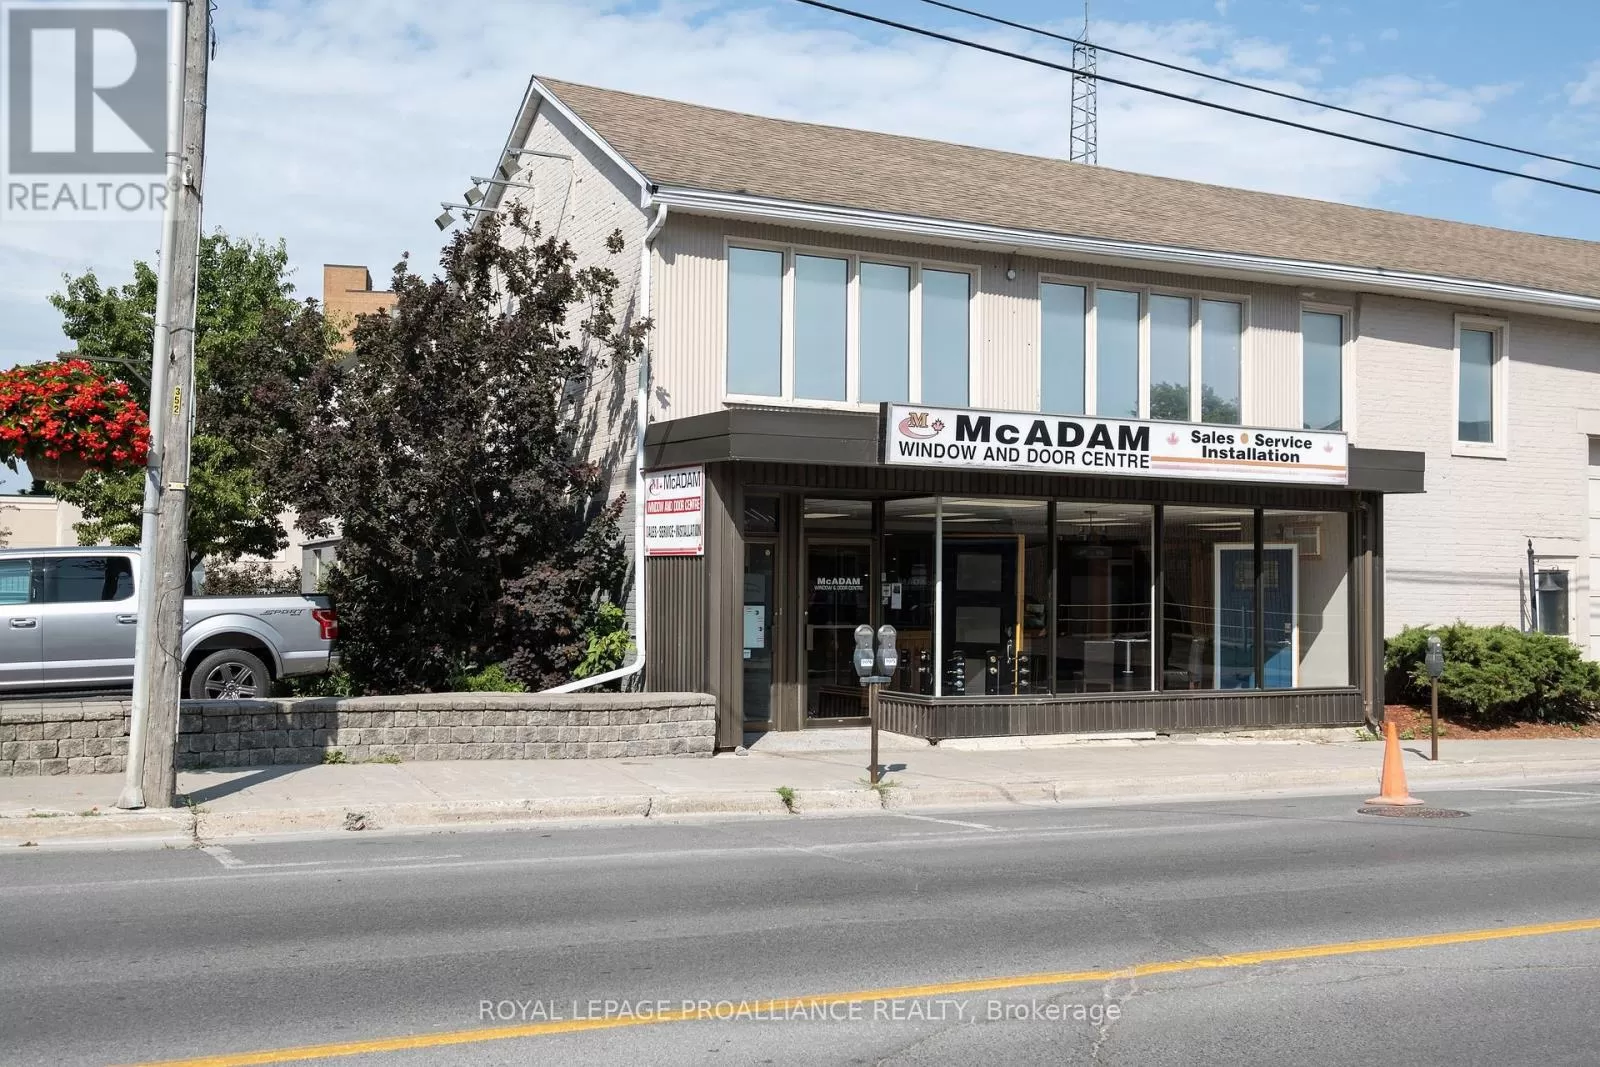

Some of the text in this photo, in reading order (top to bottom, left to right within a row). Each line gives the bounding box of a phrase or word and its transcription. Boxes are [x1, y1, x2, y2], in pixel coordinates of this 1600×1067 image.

[955, 414, 1150, 451] McADAM
[1191, 430, 1313, 449] Sales Service
[898, 441, 1150, 469] WINDOW AND DOOR CENTRE
[1201, 445, 1300, 463] Installation
[663, 471, 701, 490] McADAM
[817, 577, 861, 585] McADAM
[260, 608, 306, 616] SPORT
